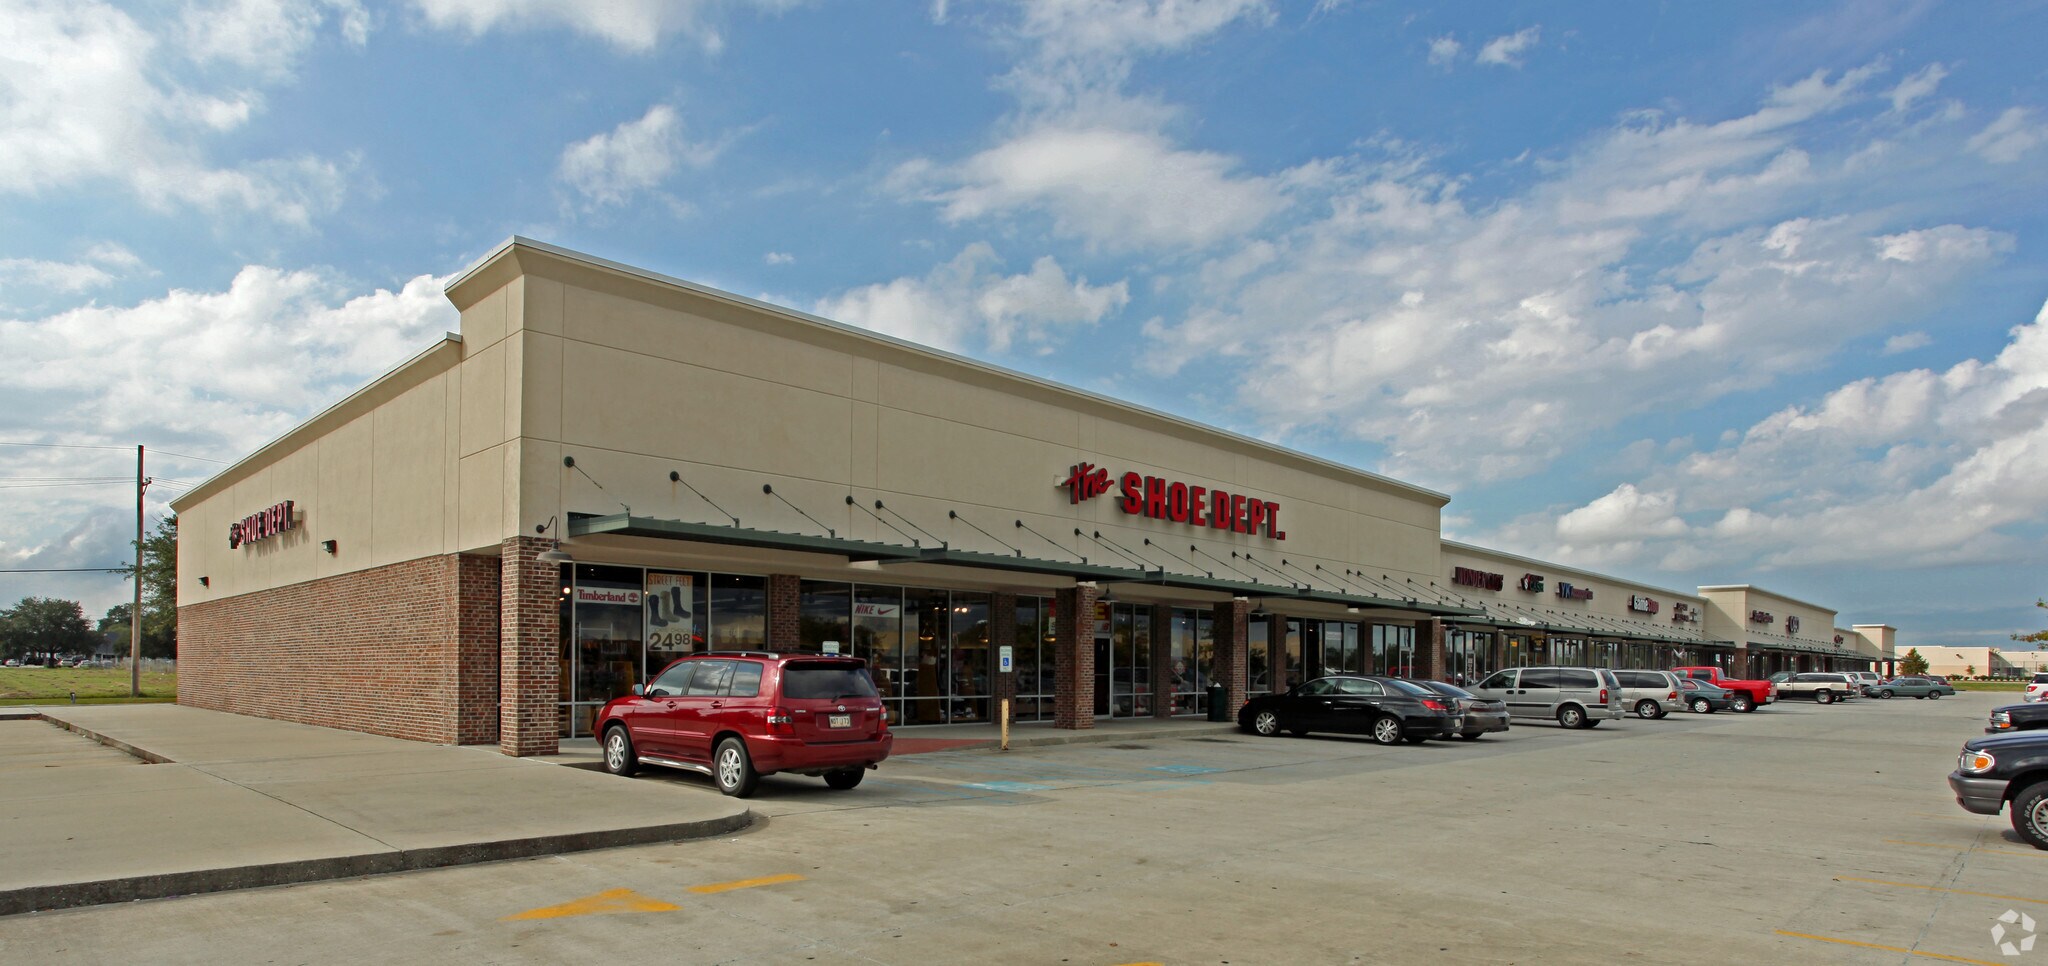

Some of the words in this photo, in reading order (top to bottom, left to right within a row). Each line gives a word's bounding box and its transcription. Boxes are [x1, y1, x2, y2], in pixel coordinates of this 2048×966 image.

[1062, 462, 1114, 504] the
[1120, 471, 1206, 526] SHOE
[1211, 490, 1285, 540] DEPT.
[240, 511, 264, 545] SHOE
[675, 575, 692, 587] FEET
[577, 589, 626, 603] Timberland
[855, 604, 875, 615] NIKE
